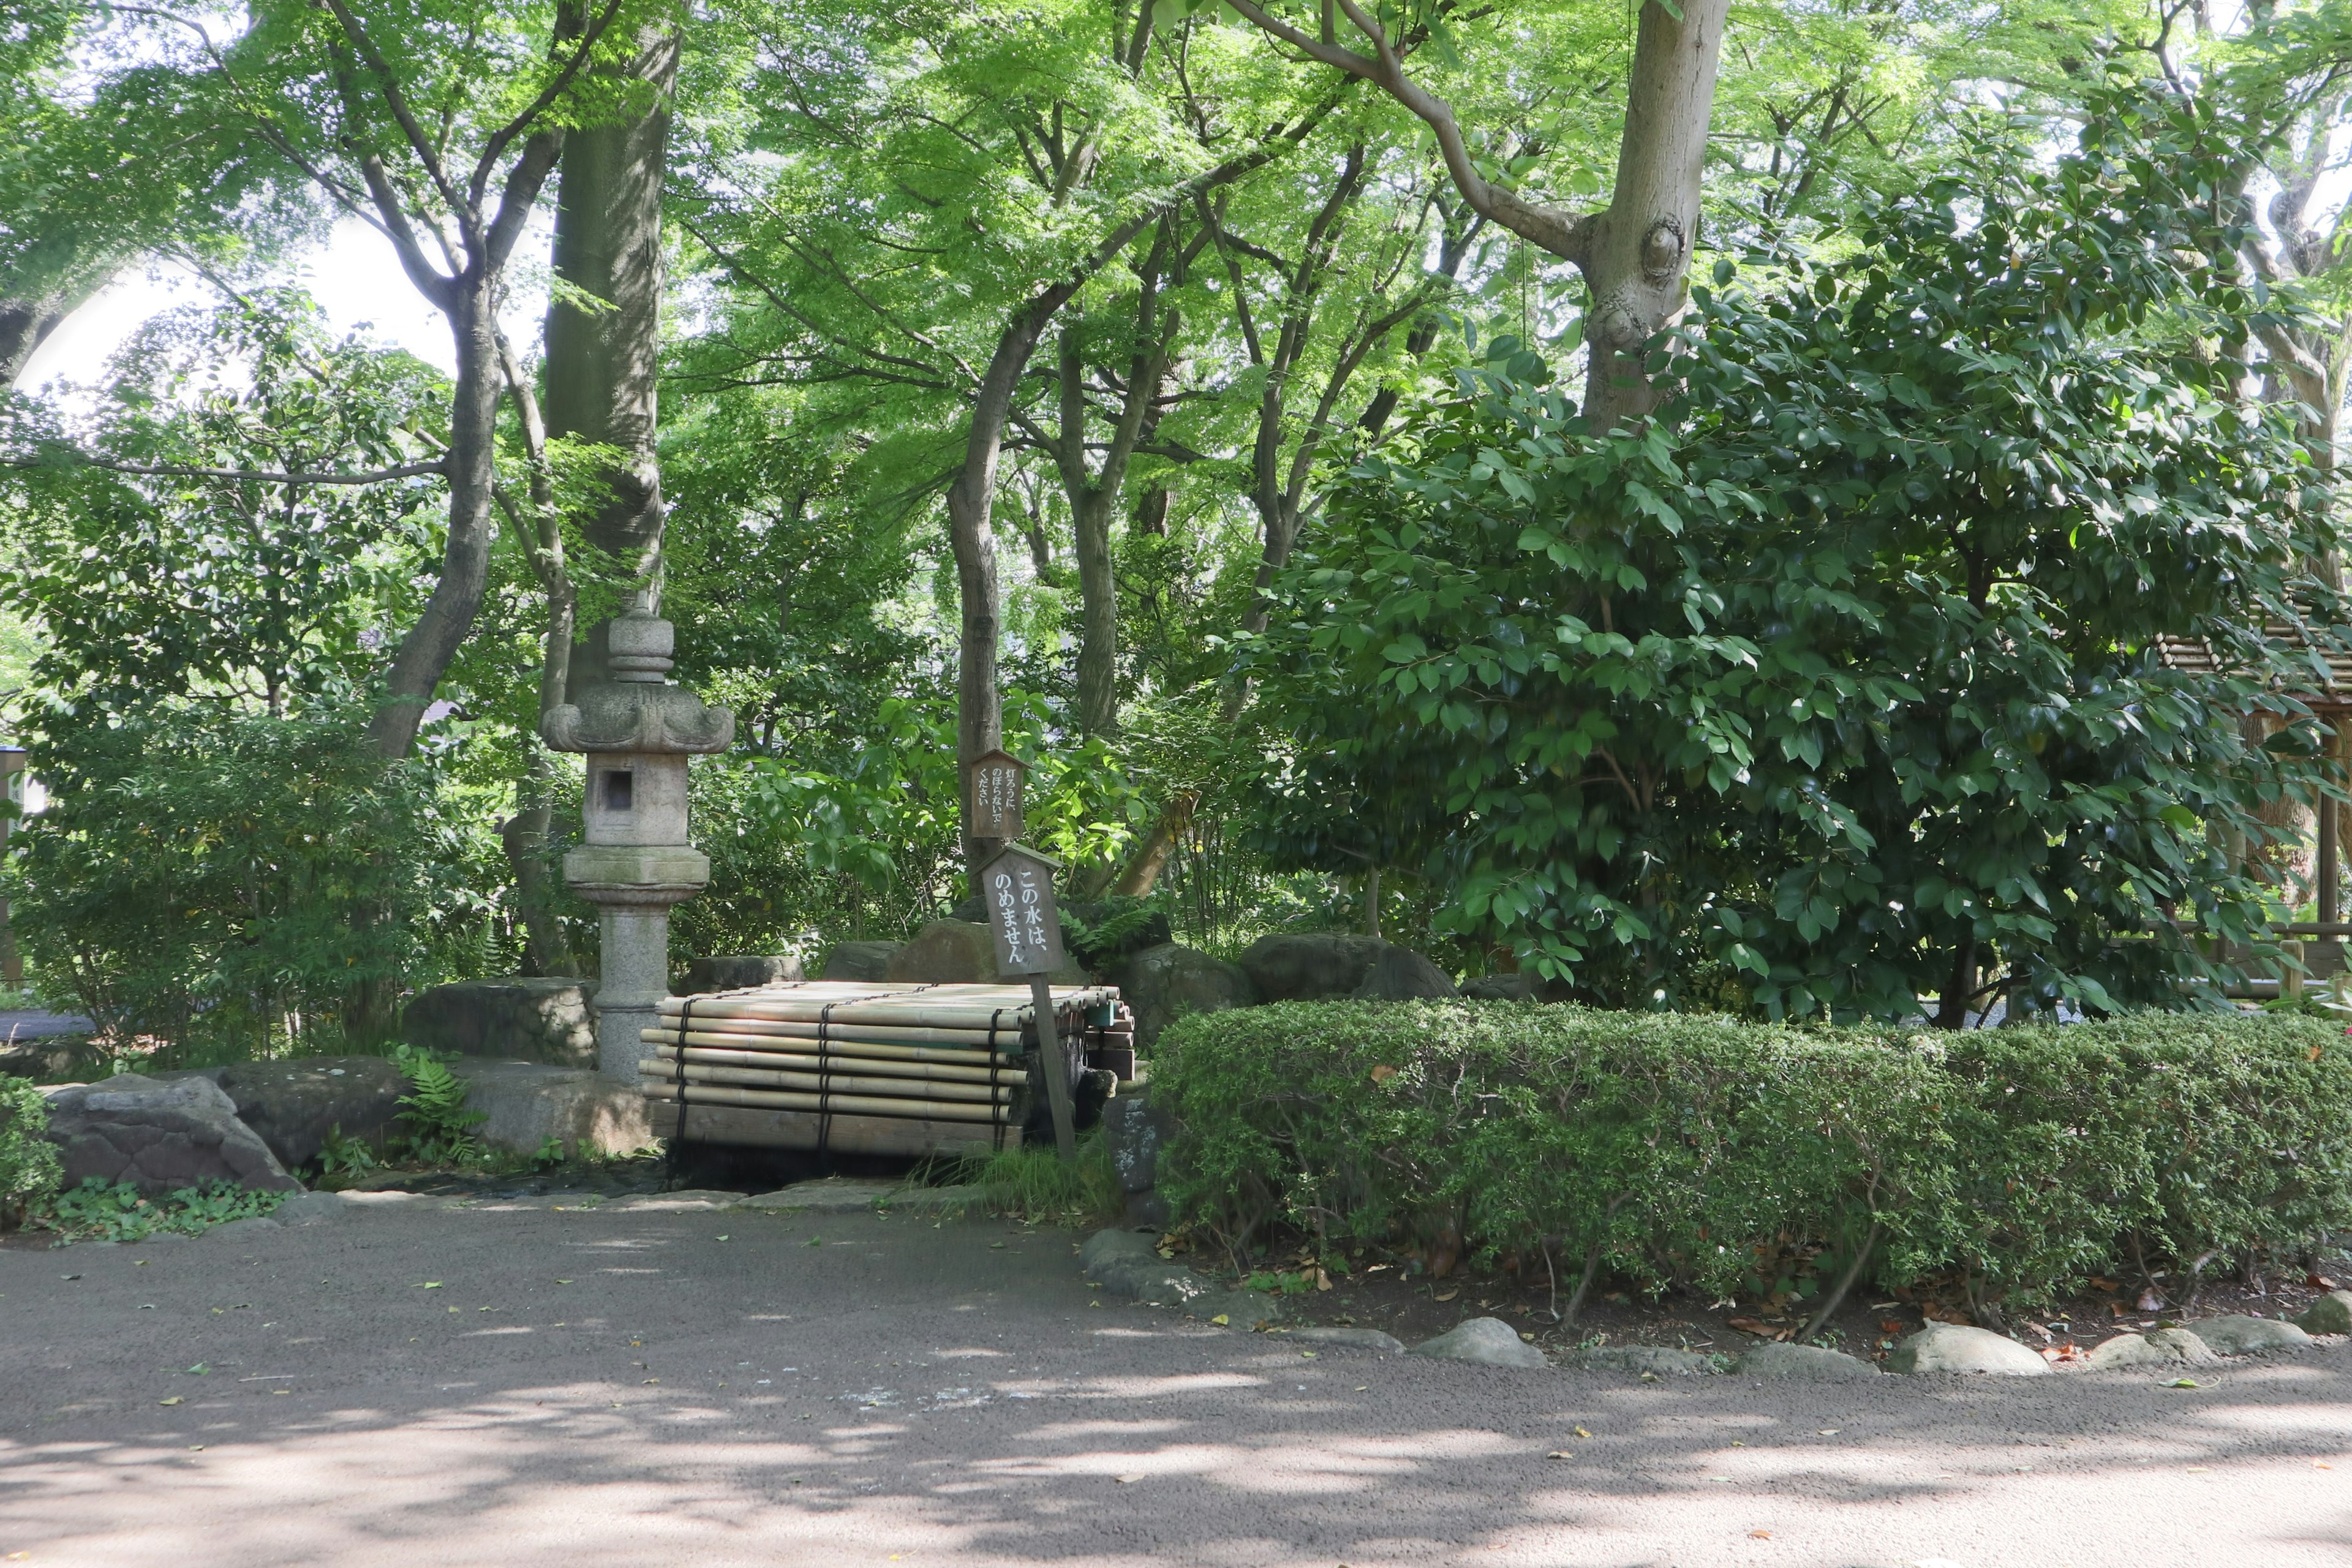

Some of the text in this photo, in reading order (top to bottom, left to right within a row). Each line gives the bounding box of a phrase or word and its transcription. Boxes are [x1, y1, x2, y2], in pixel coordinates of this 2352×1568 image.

[978, 768, 989, 806] ください
[992, 768, 1002, 822] のぼらないで
[1005, 769, 1016, 810] 灯ろうに、
[995, 873, 1024, 963] のめません
[1020, 872, 1047, 951] この水は、
